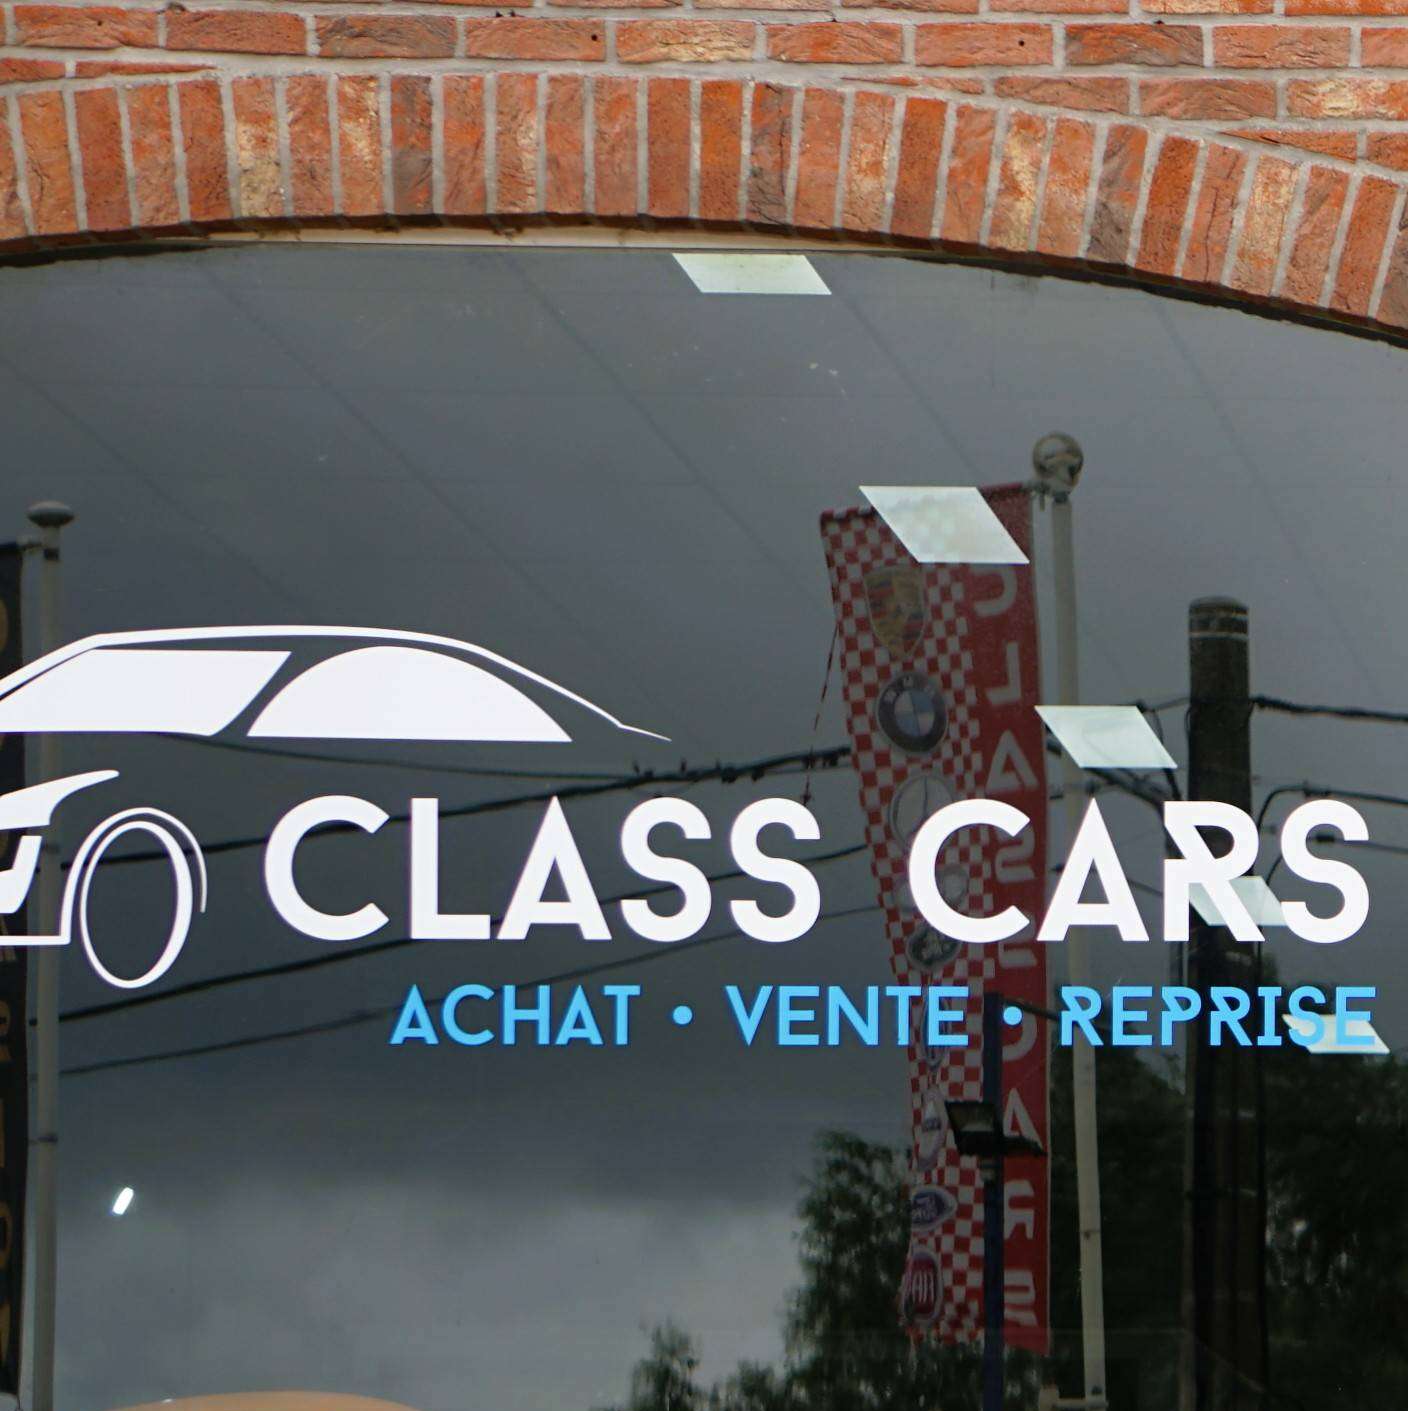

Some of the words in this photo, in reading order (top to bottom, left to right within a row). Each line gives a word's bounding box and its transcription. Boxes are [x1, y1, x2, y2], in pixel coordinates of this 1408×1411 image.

[265, 795, 822, 942] CLASS
[908, 799, 1370, 943] CARS
[389, 984, 642, 1046] ACHAT
[725, 985, 970, 1046] VENTE
[1061, 986, 1376, 1047] REPRISE
